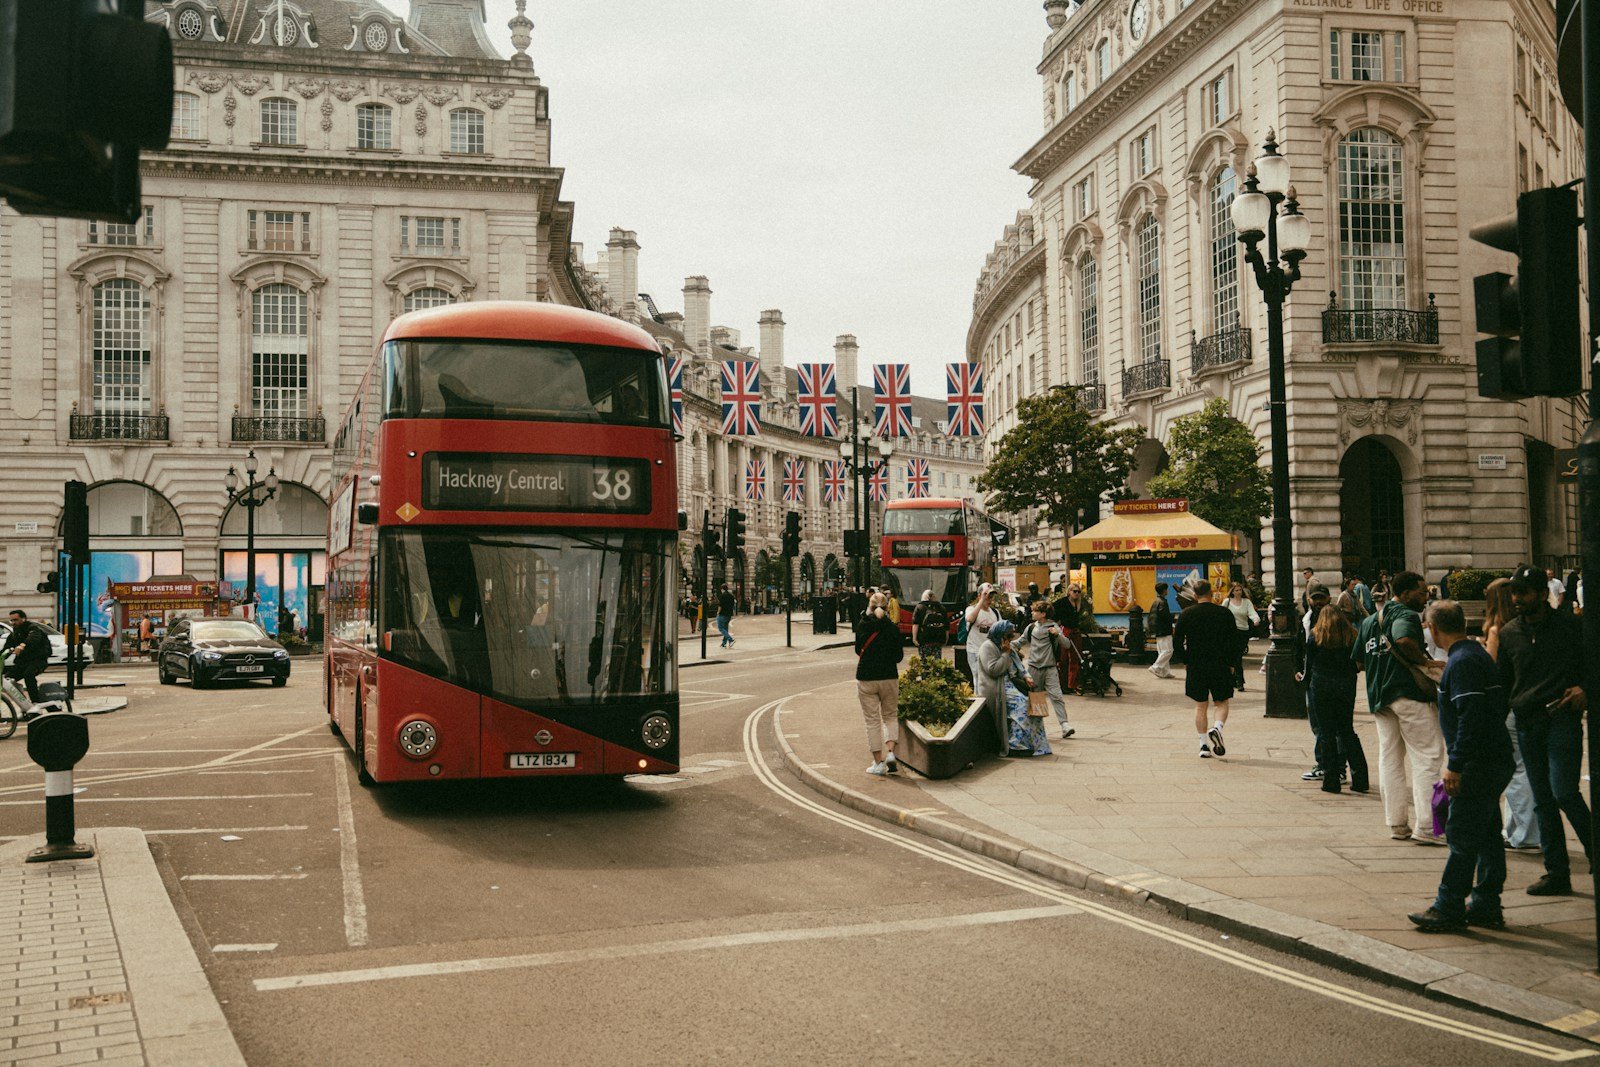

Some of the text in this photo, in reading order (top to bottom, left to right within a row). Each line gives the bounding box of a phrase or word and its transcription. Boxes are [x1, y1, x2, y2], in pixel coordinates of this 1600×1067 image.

[1365, 0, 1390, 11] LIFE
[1402, 0, 1443, 13] OFFICE
[1320, 354, 1359, 363] COUNTY
[1429, 355, 1461, 364] OFFICE
[439, 467, 632, 500] Hackney Central 38
[1114, 503, 1128, 511] BUY
[1157, 502, 1177, 510] HERE
[936, 541, 952, 554] 94
[1092, 538, 1199, 550] HOT DOG SPOT
[129, 601, 205, 611] BUY TICKETS HERE
[517, 754, 568, 767] LTZ 1834
